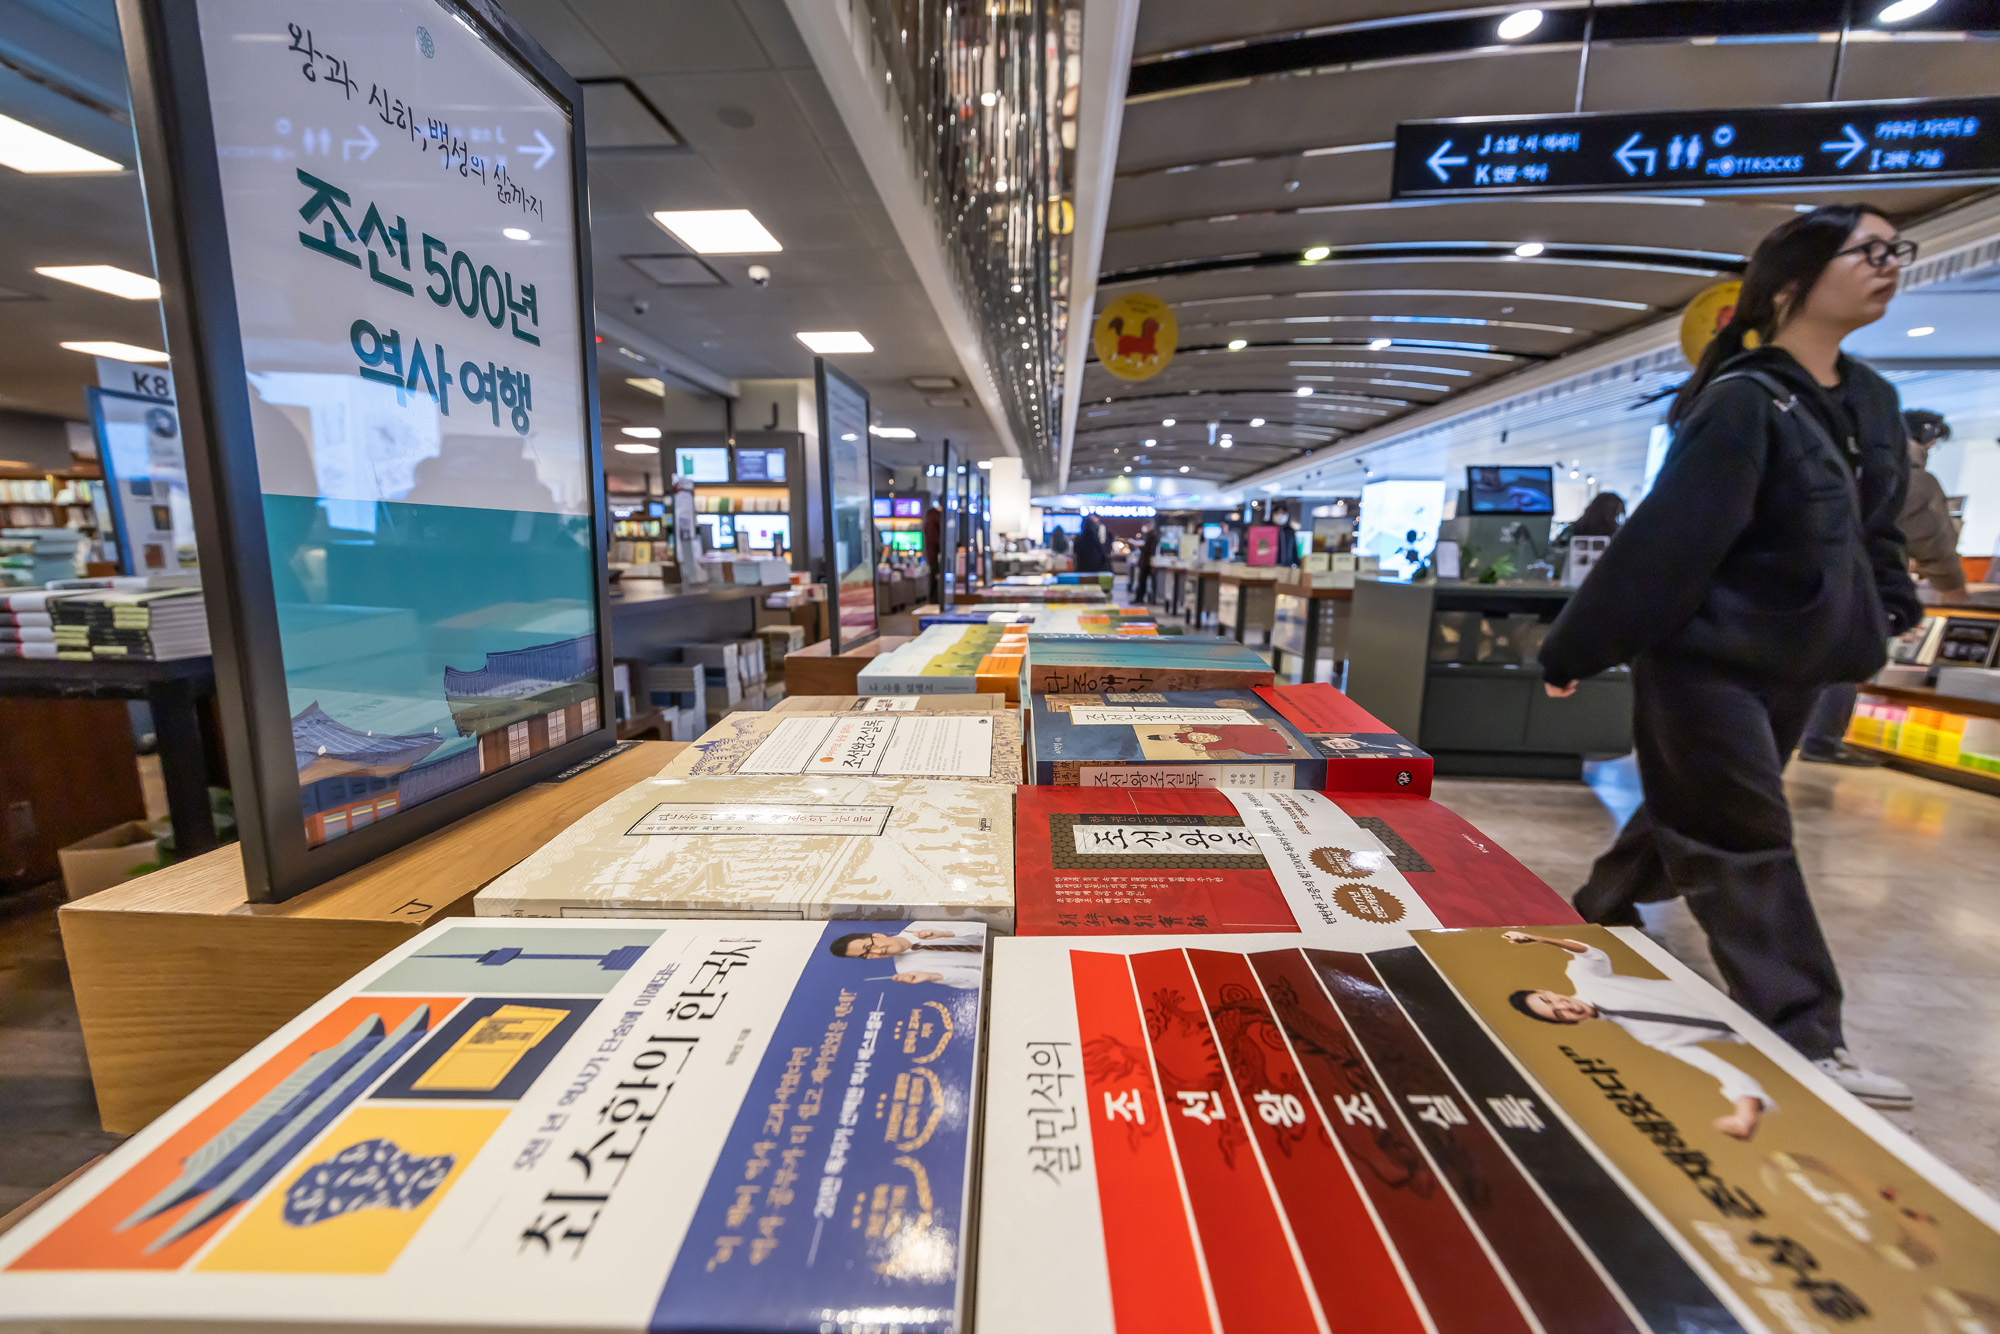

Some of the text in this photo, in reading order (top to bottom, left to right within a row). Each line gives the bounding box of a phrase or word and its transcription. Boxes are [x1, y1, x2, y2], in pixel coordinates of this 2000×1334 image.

[287, 21, 544, 221] 왕과 신하, 백성의 삶까지
[1477, 134, 1491, 155] J
[1475, 163, 1490, 185] K
[296, 167, 541, 347] 조선 500년
[132, 371, 169, 397] K8
[350, 318, 532, 436] 역사 여행
[1086, 713, 1234, 724] 조선왕조실록
[842, 719, 885, 769] 조선왕조실록
[1094, 771, 1204, 788] 조선왕조실록
[1289, 854, 1306, 869] 200만
[1303, 881, 1323, 901] 고증의
[1347, 891, 1373, 913] 2017년
[1358, 887, 1389, 919] 전면개정판
[1314, 903, 1337, 924] 탄탄한
[598, 1009, 643, 1054] 단숨에
[634, 962, 682, 1007] 이해되는
[856, 1011, 884, 1060] 베스트셀러
[850, 1063, 869, 1085] 역사
[518, 935, 762, 1260] 최소한의 한국사
[1026, 1041, 1082, 1187] 설민석의
[1104, 1088, 1550, 1134] 조선왕조실록
[790, 1126, 813, 1143] 더
[744, 1142, 777, 1180] 역사
[766, 1148, 805, 1207] 공부가
[749, 1217, 785, 1265] 역사
